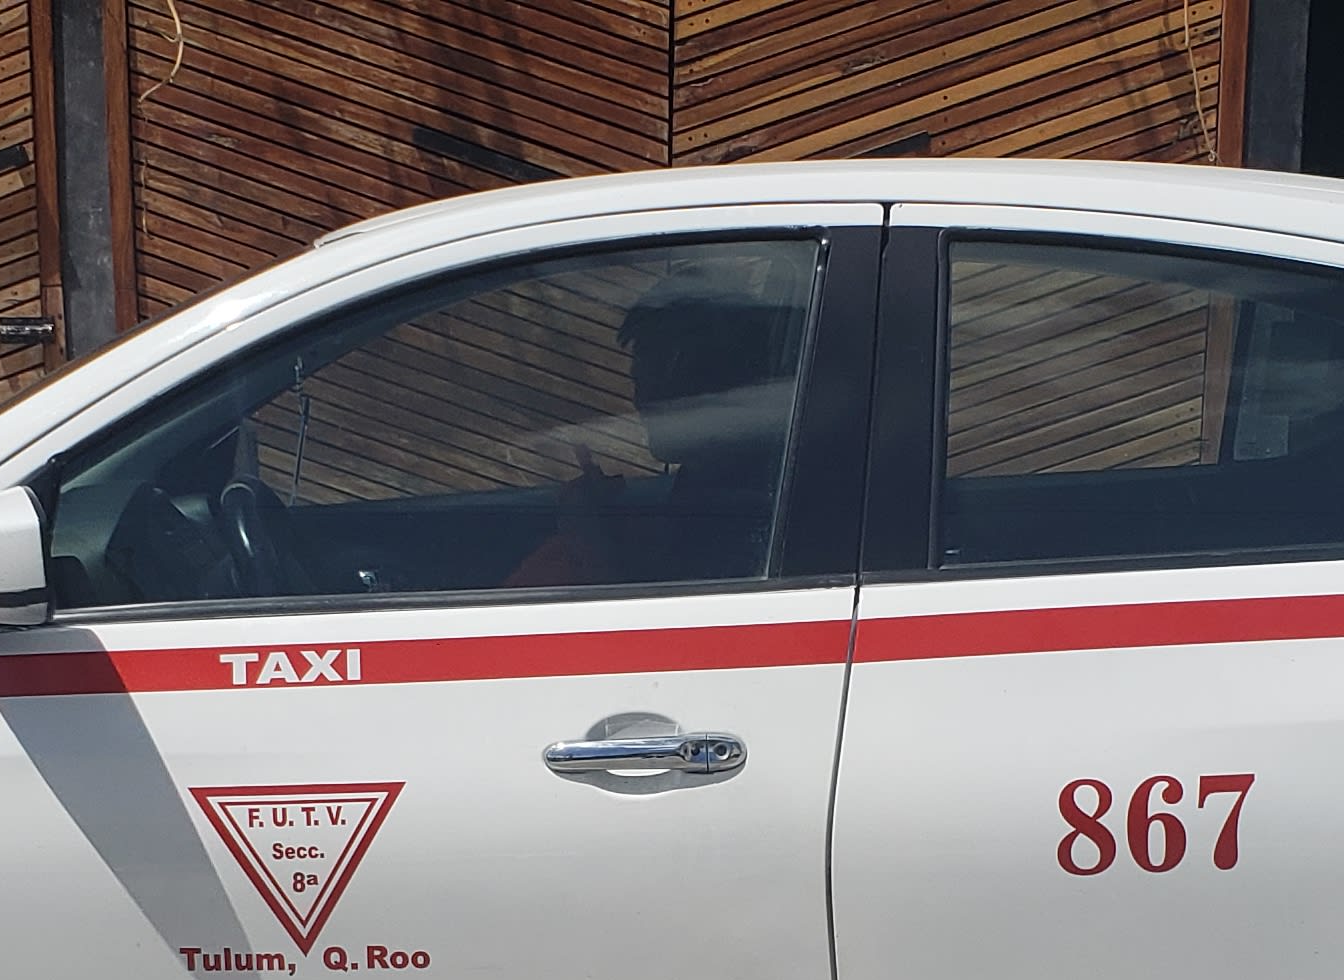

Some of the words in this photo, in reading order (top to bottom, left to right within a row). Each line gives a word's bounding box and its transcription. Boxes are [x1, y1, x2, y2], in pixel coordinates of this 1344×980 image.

[219, 648, 362, 686] TAXI
[247, 808, 265, 828] F.
[271, 807, 295, 828] U.
[301, 806, 320, 827] T.
[326, 805, 347, 826] V.
[1056, 773, 1256, 877] 867
[271, 842, 325, 860] Secc.
[179, 947, 297, 977] Tulum,
[322, 946, 359, 973] Q.
[366, 945, 431, 971] Roo
